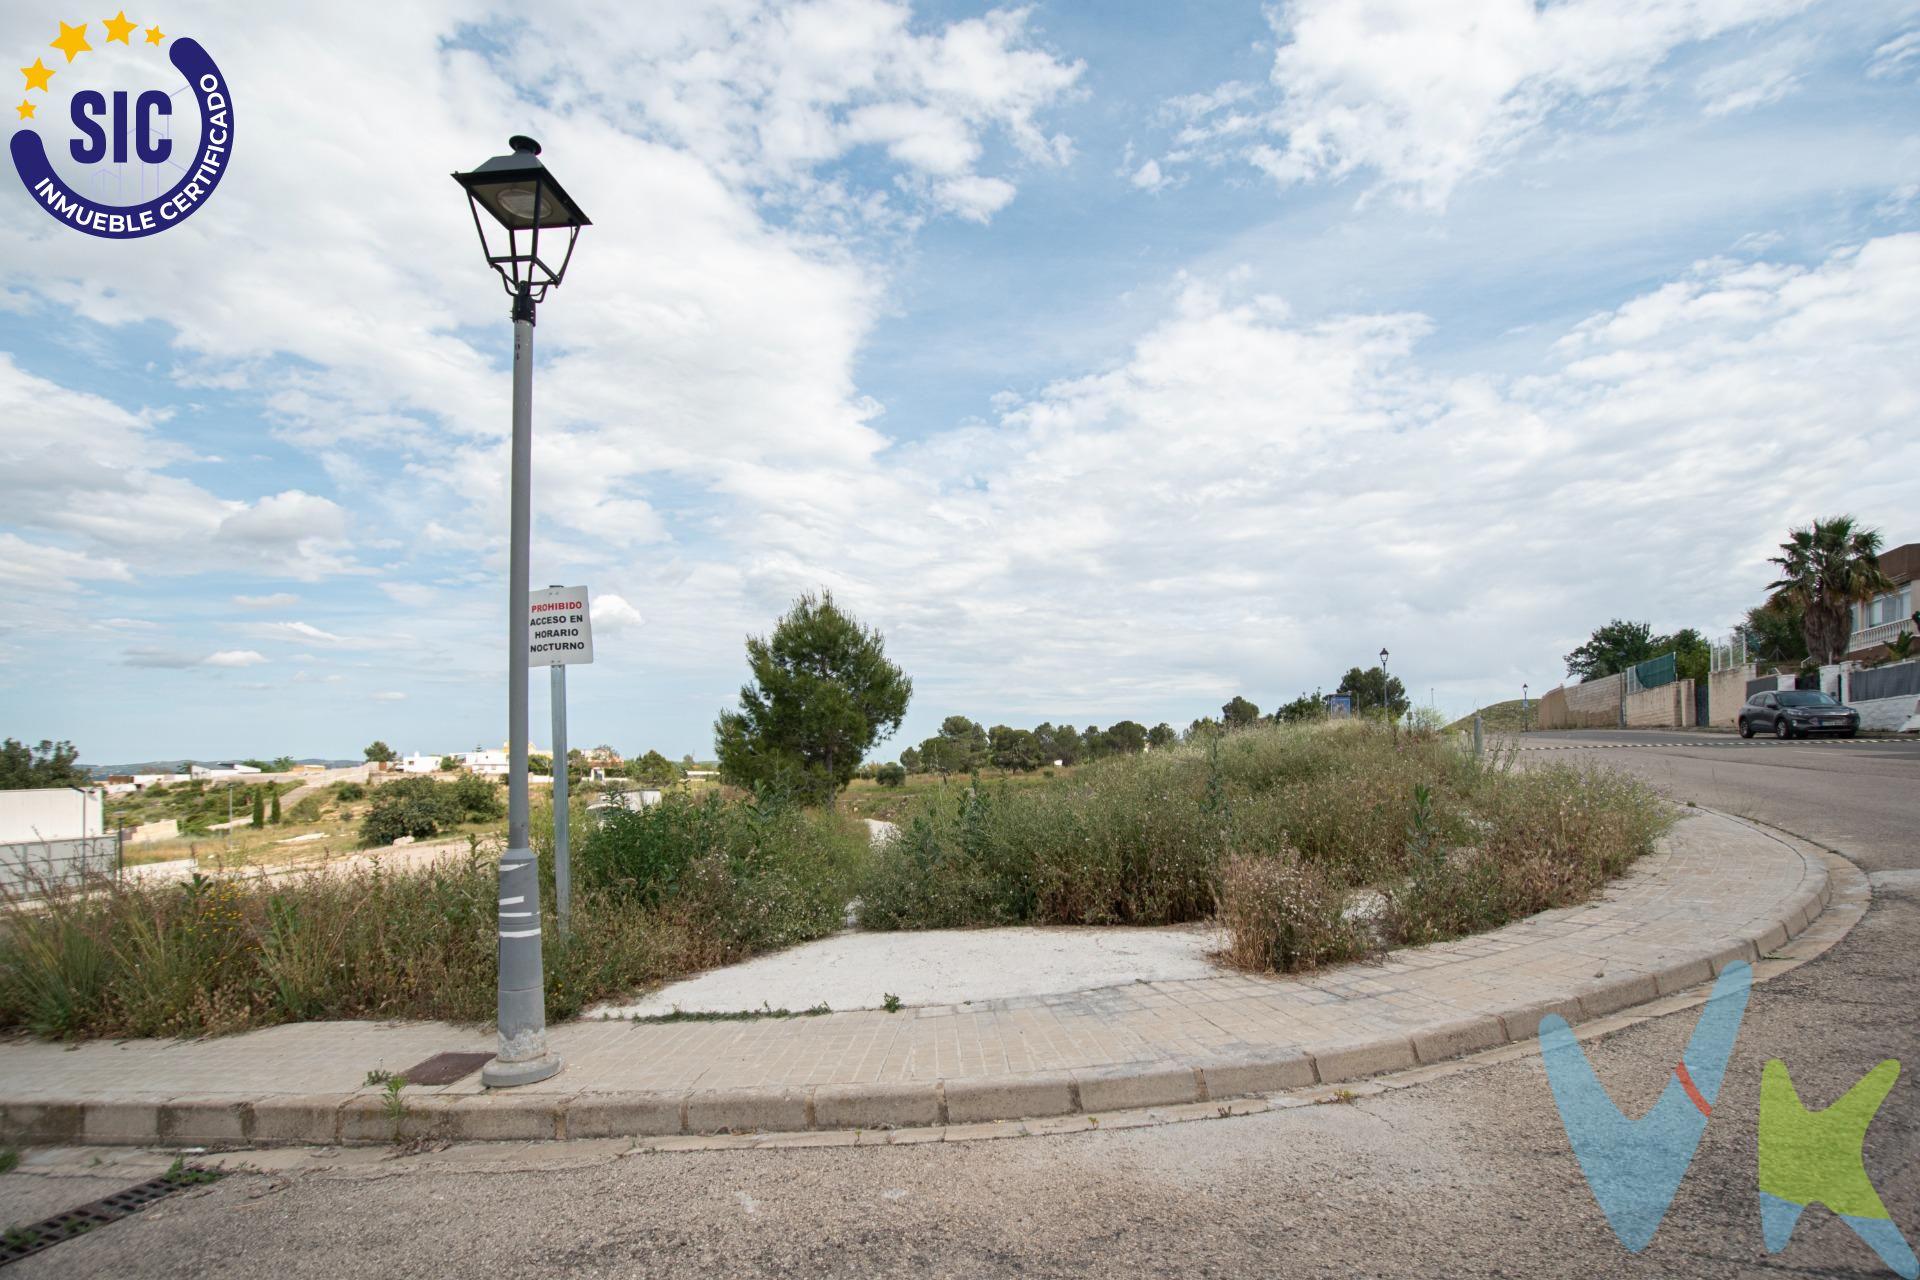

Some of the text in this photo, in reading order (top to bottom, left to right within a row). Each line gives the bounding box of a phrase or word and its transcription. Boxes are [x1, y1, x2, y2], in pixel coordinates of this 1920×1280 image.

[532, 601, 582, 613] PROHIBIDO
[530, 615, 583, 626] ACCESO EN
[535, 629, 578, 639] HORARIO
[530, 642, 584, 652] NOCTURNO
